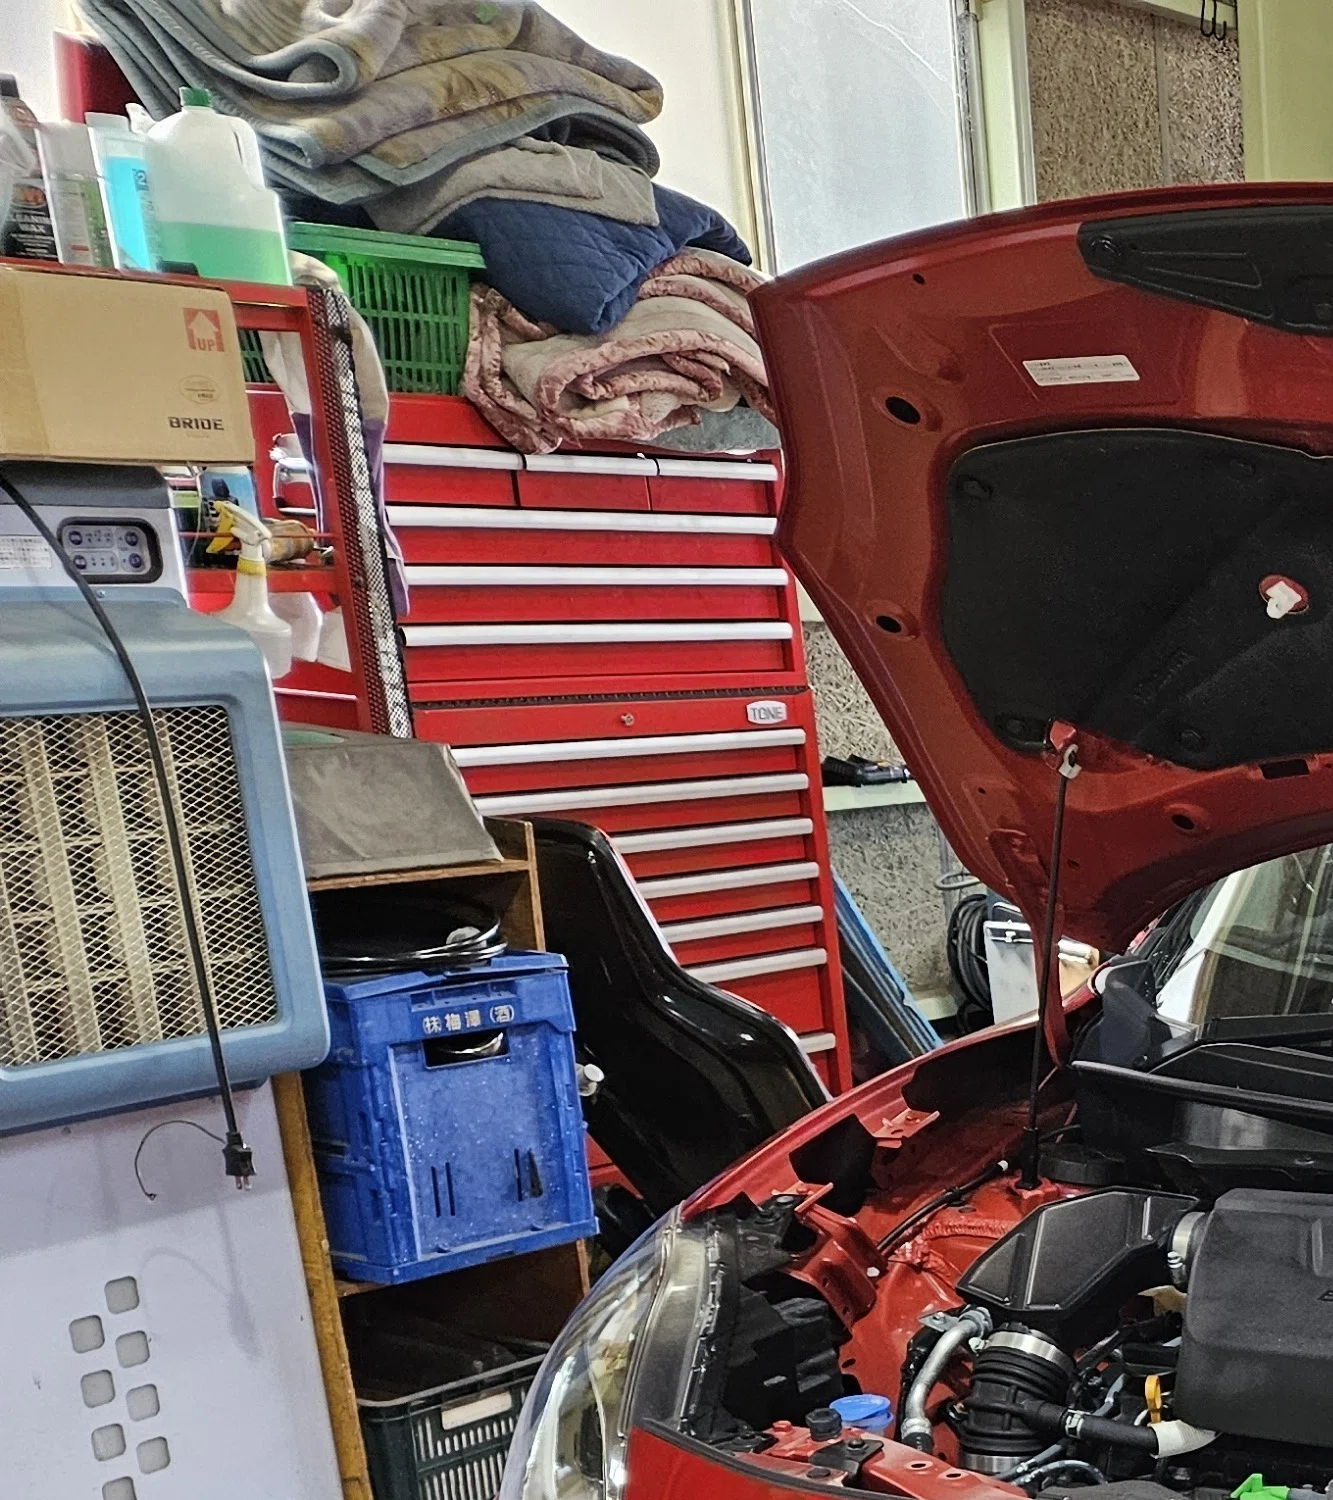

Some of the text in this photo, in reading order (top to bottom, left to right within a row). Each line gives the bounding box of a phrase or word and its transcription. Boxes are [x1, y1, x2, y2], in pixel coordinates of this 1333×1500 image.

[197, 339, 216, 351] UP
[168, 417, 224, 431] BRIDE
[750, 707, 783, 721] TONE
